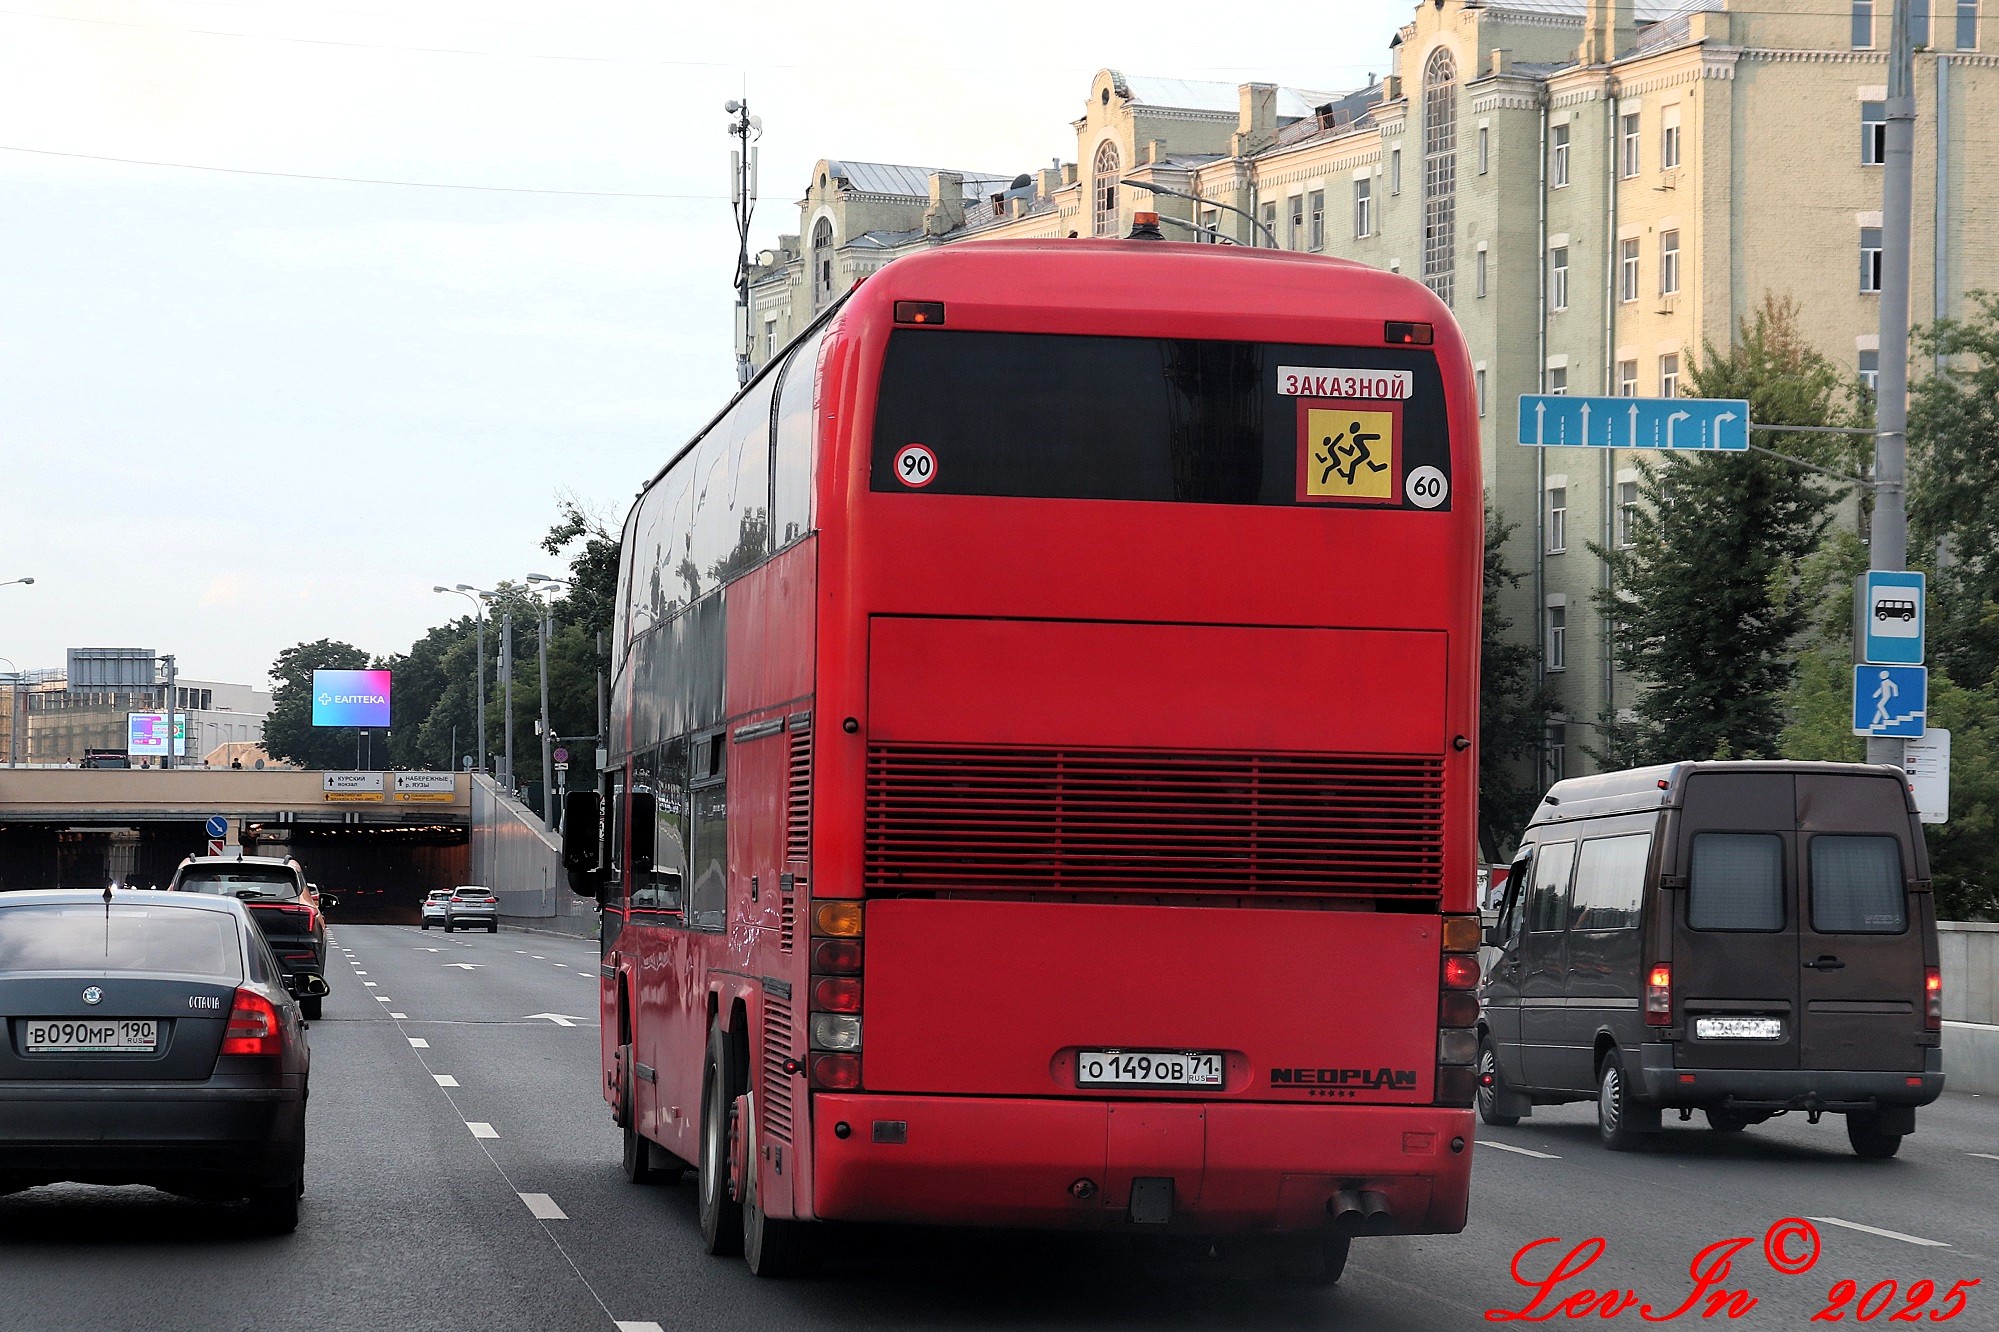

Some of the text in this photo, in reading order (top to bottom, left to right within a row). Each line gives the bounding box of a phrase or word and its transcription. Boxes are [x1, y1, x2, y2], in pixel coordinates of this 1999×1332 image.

[1286, 374, 1404, 398] ЗАКАЗНОЙ
[903, 455, 930, 476] 90
[1413, 476, 1440, 498] 60
[335, 695, 385, 704] ЕАПТЕКА
[188, 995, 220, 1010] OCTAVIA
[34, 1022, 151, 1044] В090МР 190
[1190, 1056, 1213, 1074] 71
[1189, 1074, 1205, 1082] RUS
[1271, 1068, 1416, 1090] NEOPLAN
